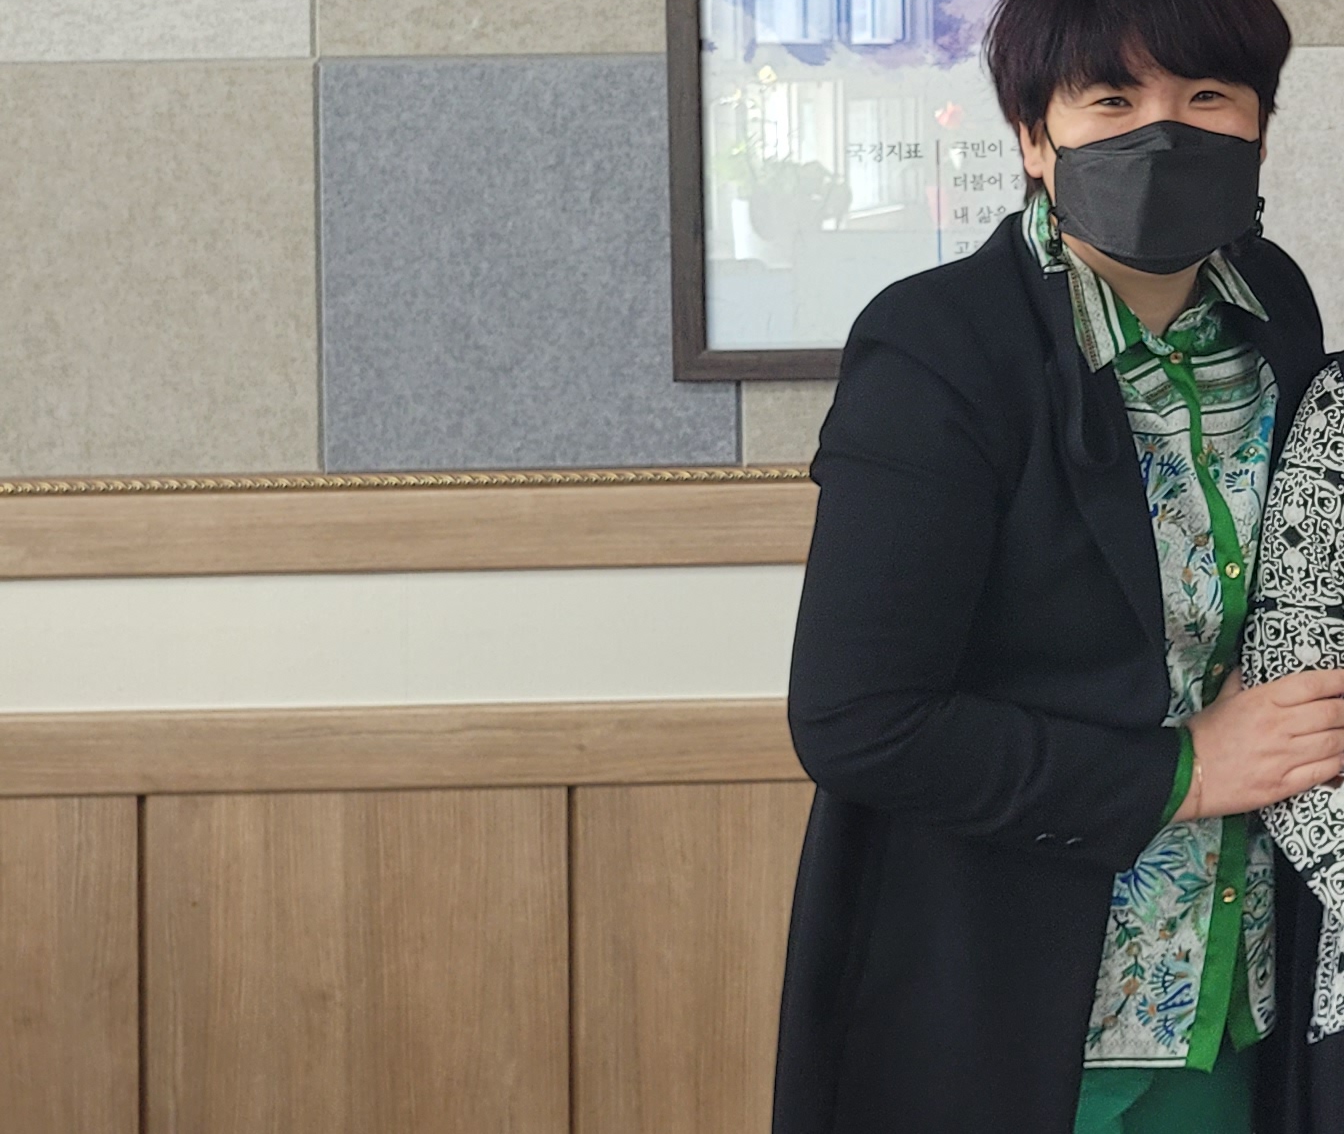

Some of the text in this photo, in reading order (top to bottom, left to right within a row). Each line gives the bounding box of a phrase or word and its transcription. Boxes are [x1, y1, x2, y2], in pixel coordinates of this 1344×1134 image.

[847, 141, 924, 162] 국정지표
[952, 139, 1002, 158] 국민이
[953, 172, 1003, 191] 더불어
[954, 206, 969, 224] 내
